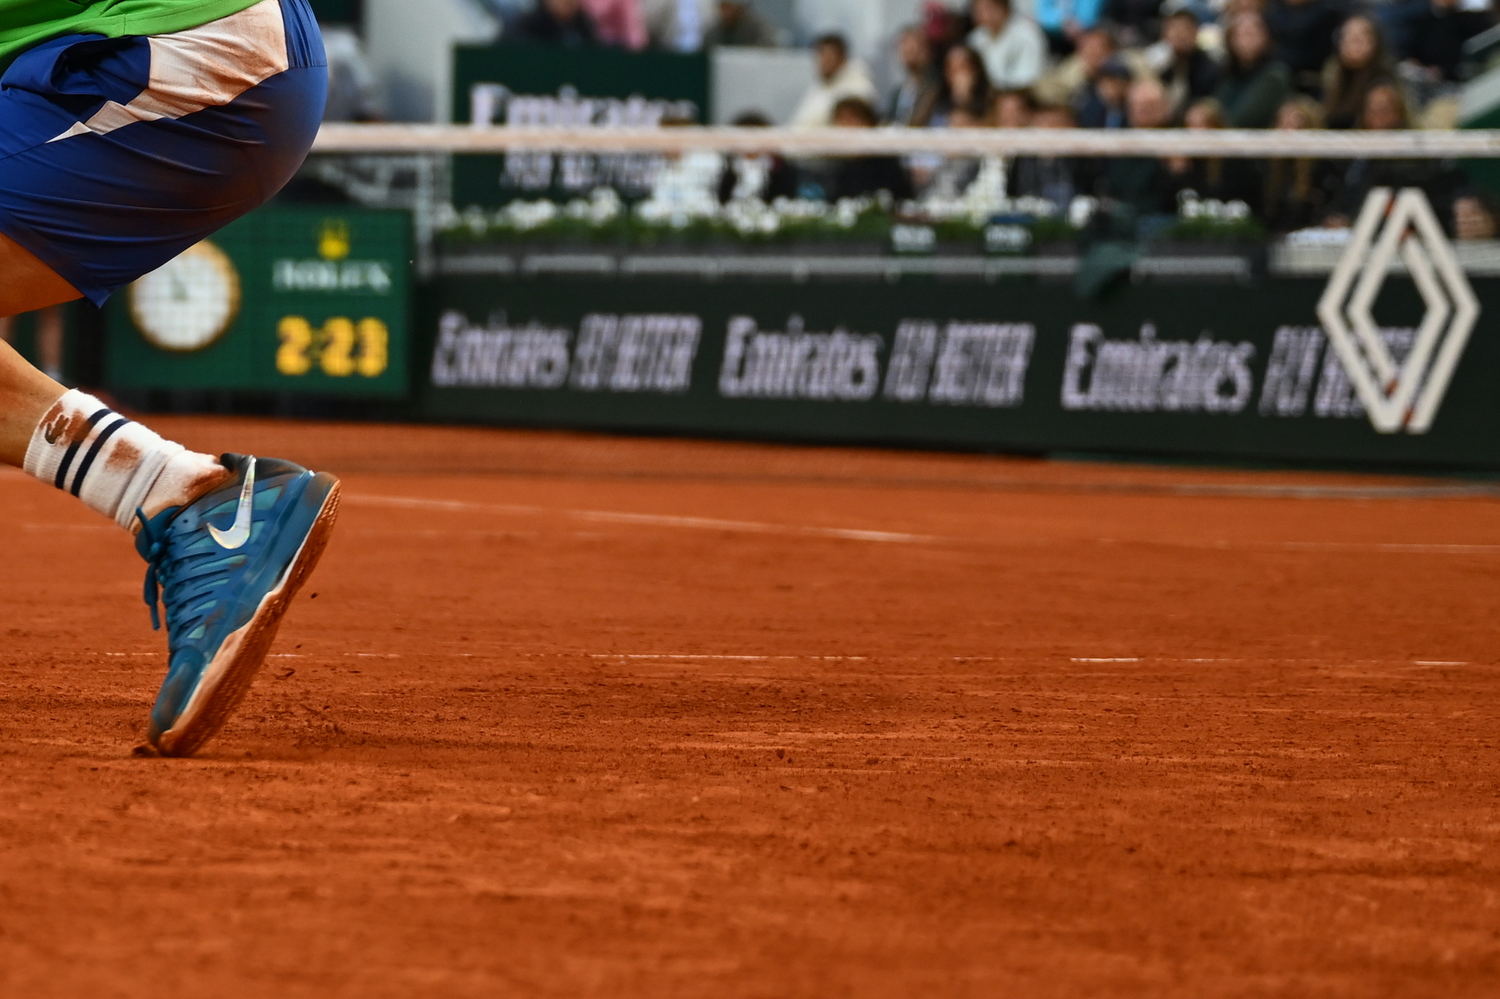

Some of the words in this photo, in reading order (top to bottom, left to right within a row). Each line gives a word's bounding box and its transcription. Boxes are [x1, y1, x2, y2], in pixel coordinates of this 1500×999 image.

[431, 310, 571, 389] Emirates
[718, 313, 884, 400] Emirates
[1060, 319, 1256, 412] Emirates
